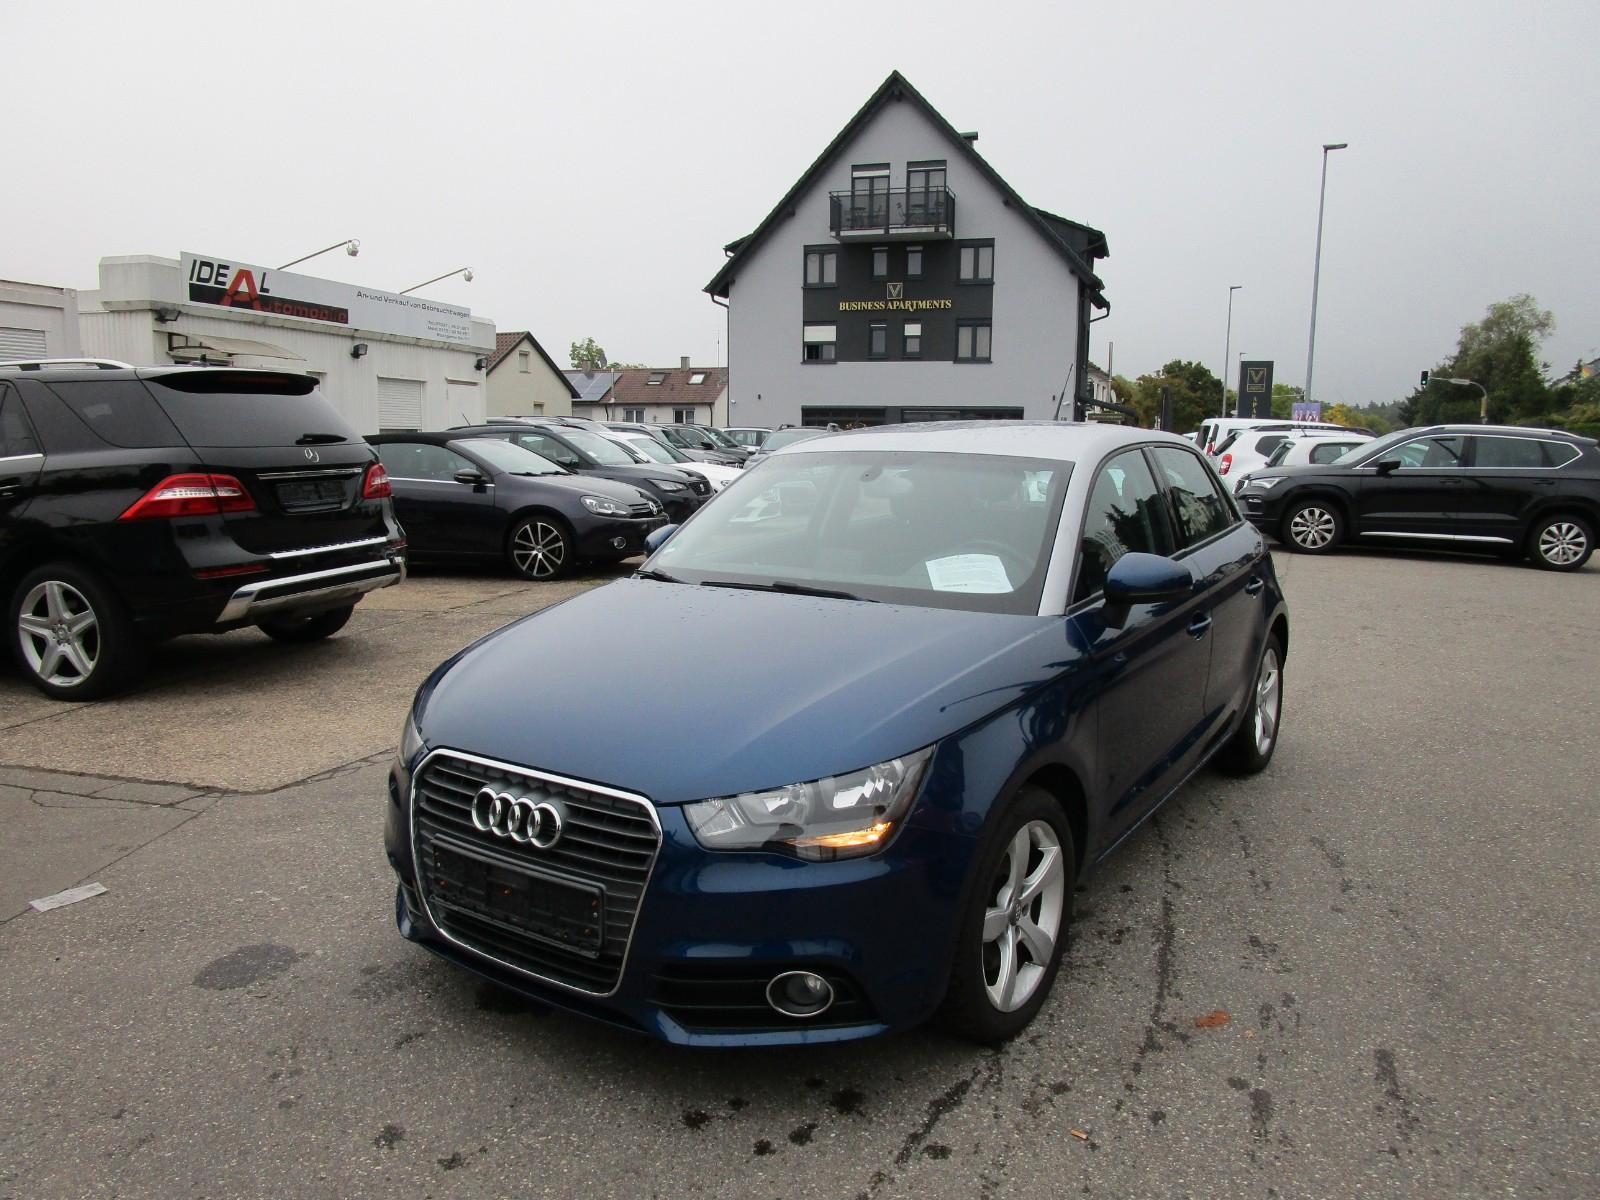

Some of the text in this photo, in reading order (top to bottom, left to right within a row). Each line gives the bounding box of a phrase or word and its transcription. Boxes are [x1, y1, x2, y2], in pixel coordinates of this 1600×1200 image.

[189, 259, 270, 307] IDEAL
[383, 296, 409, 307] Verkauf
[422, 303, 470, 318] Gebrauchtwagen
[839, 299, 952, 312] BUSINESS APARTMENTS
